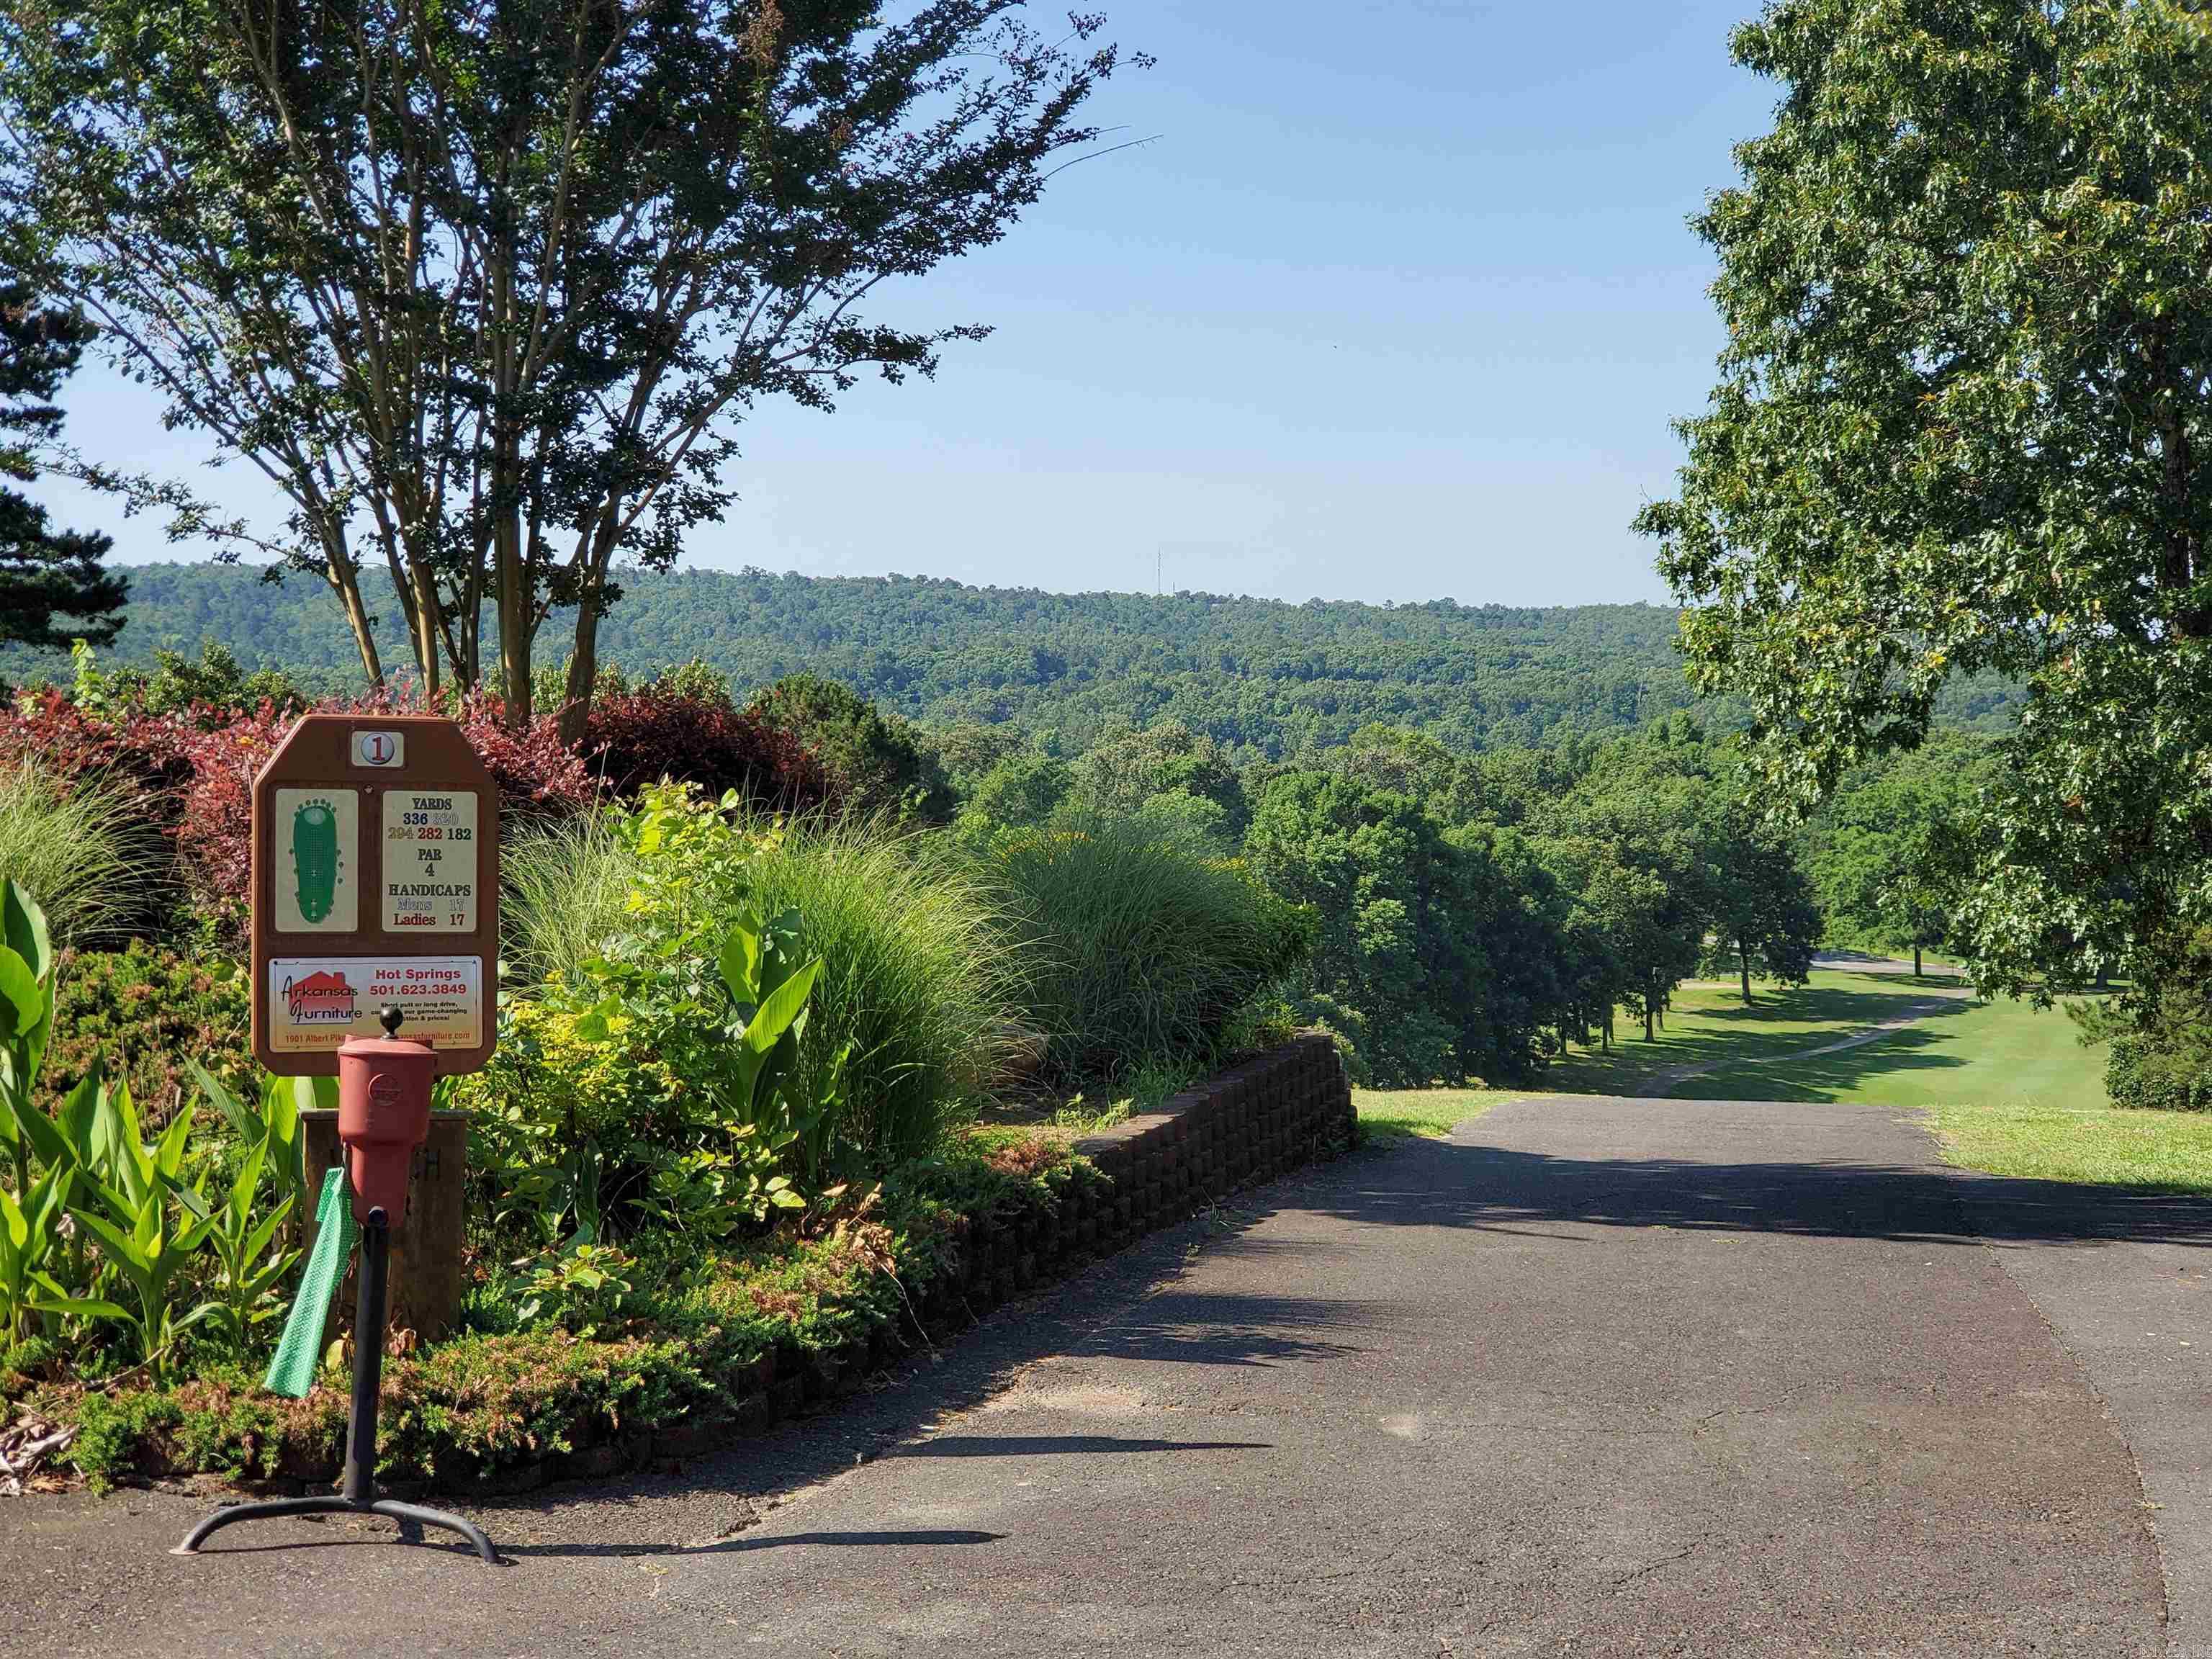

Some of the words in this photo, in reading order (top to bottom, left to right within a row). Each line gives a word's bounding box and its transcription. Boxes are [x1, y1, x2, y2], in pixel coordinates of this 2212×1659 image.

[372, 737, 385, 760] 1
[412, 798, 452, 810] YARDS
[403, 813, 428, 824] 336
[388, 827, 415, 840] 294
[418, 827, 443, 840] 282
[448, 828, 472, 840] 182
[418, 848, 442, 860] PAR
[425, 863, 435, 876] 4
[388, 884, 471, 896] HANDICAPS
[397, 899, 433, 911] Mens
[393, 913, 436, 926] Ladies
[450, 913, 466, 926] 17
[376, 969, 401, 980] Hot
[405, 968, 461, 981] Springs
[281, 975, 359, 1002] Arkansas
[369, 984, 467, 995] 501.623.3849
[290, 999, 363, 1023] Furniture
[305, 1034, 328, 1043] Albert
